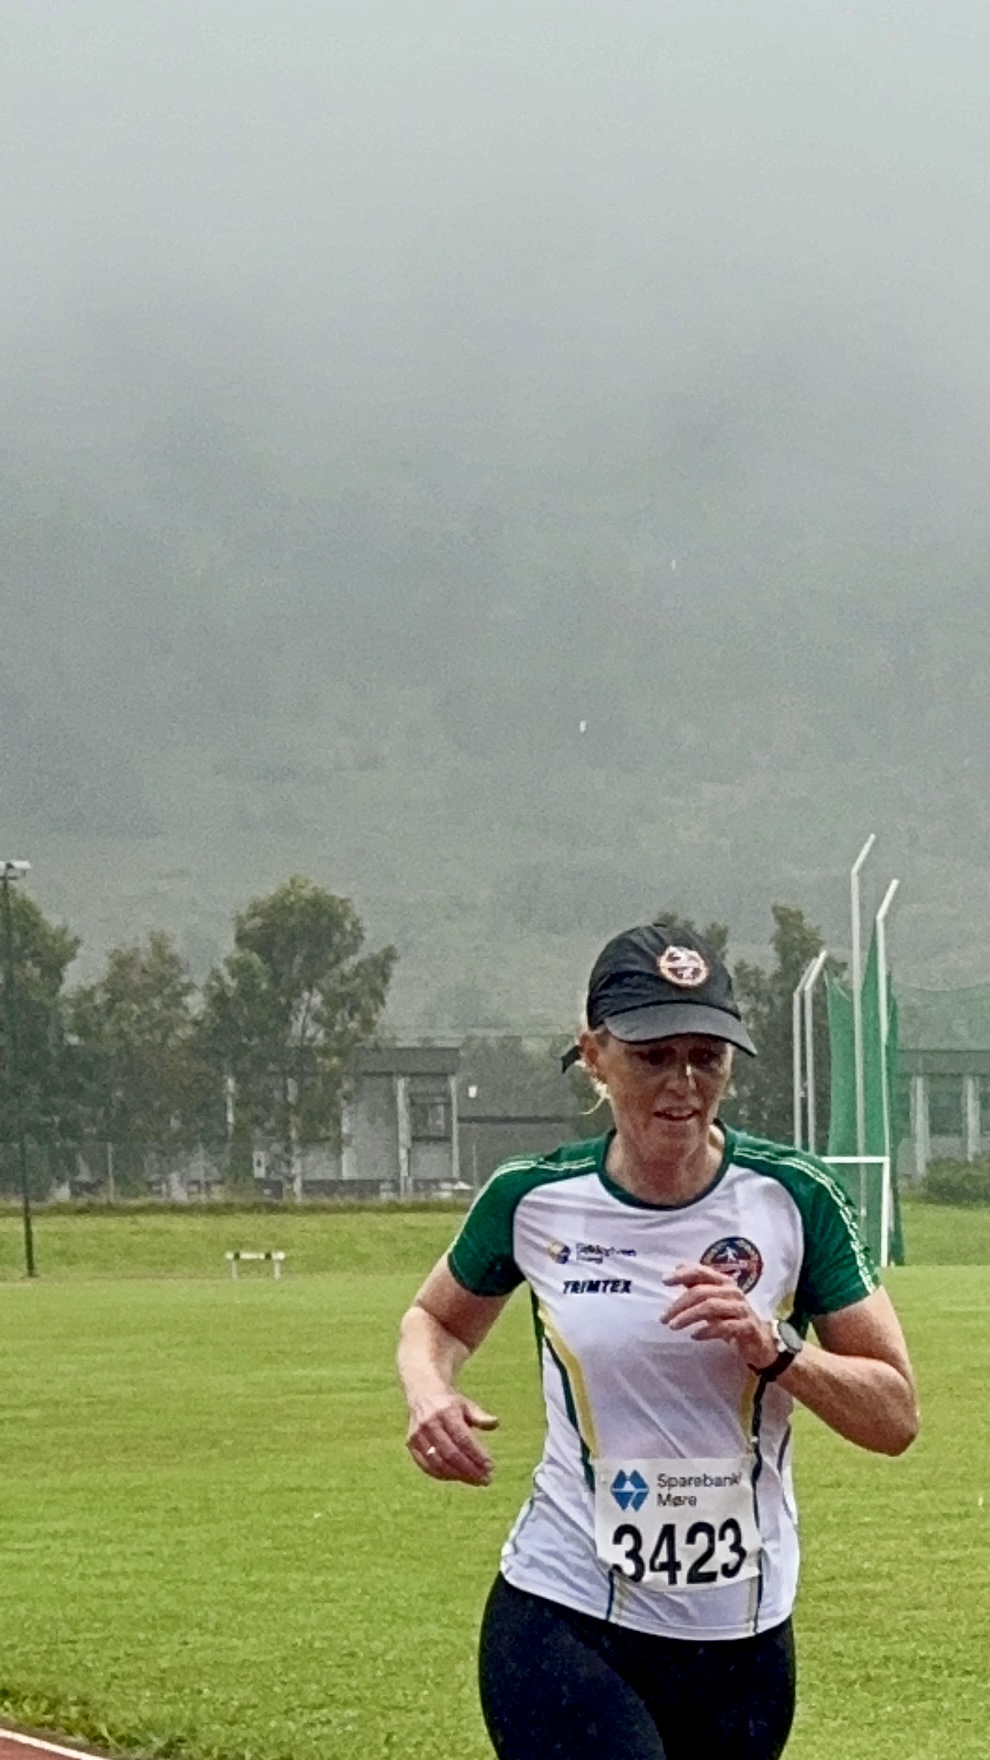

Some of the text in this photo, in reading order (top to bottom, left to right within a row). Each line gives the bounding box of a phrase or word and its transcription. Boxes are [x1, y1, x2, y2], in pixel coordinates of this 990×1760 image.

[563, 1279, 632, 1295] TRIMTEX
[656, 1493, 698, 1507] Møre
[612, 1517, 748, 1586] 3423
